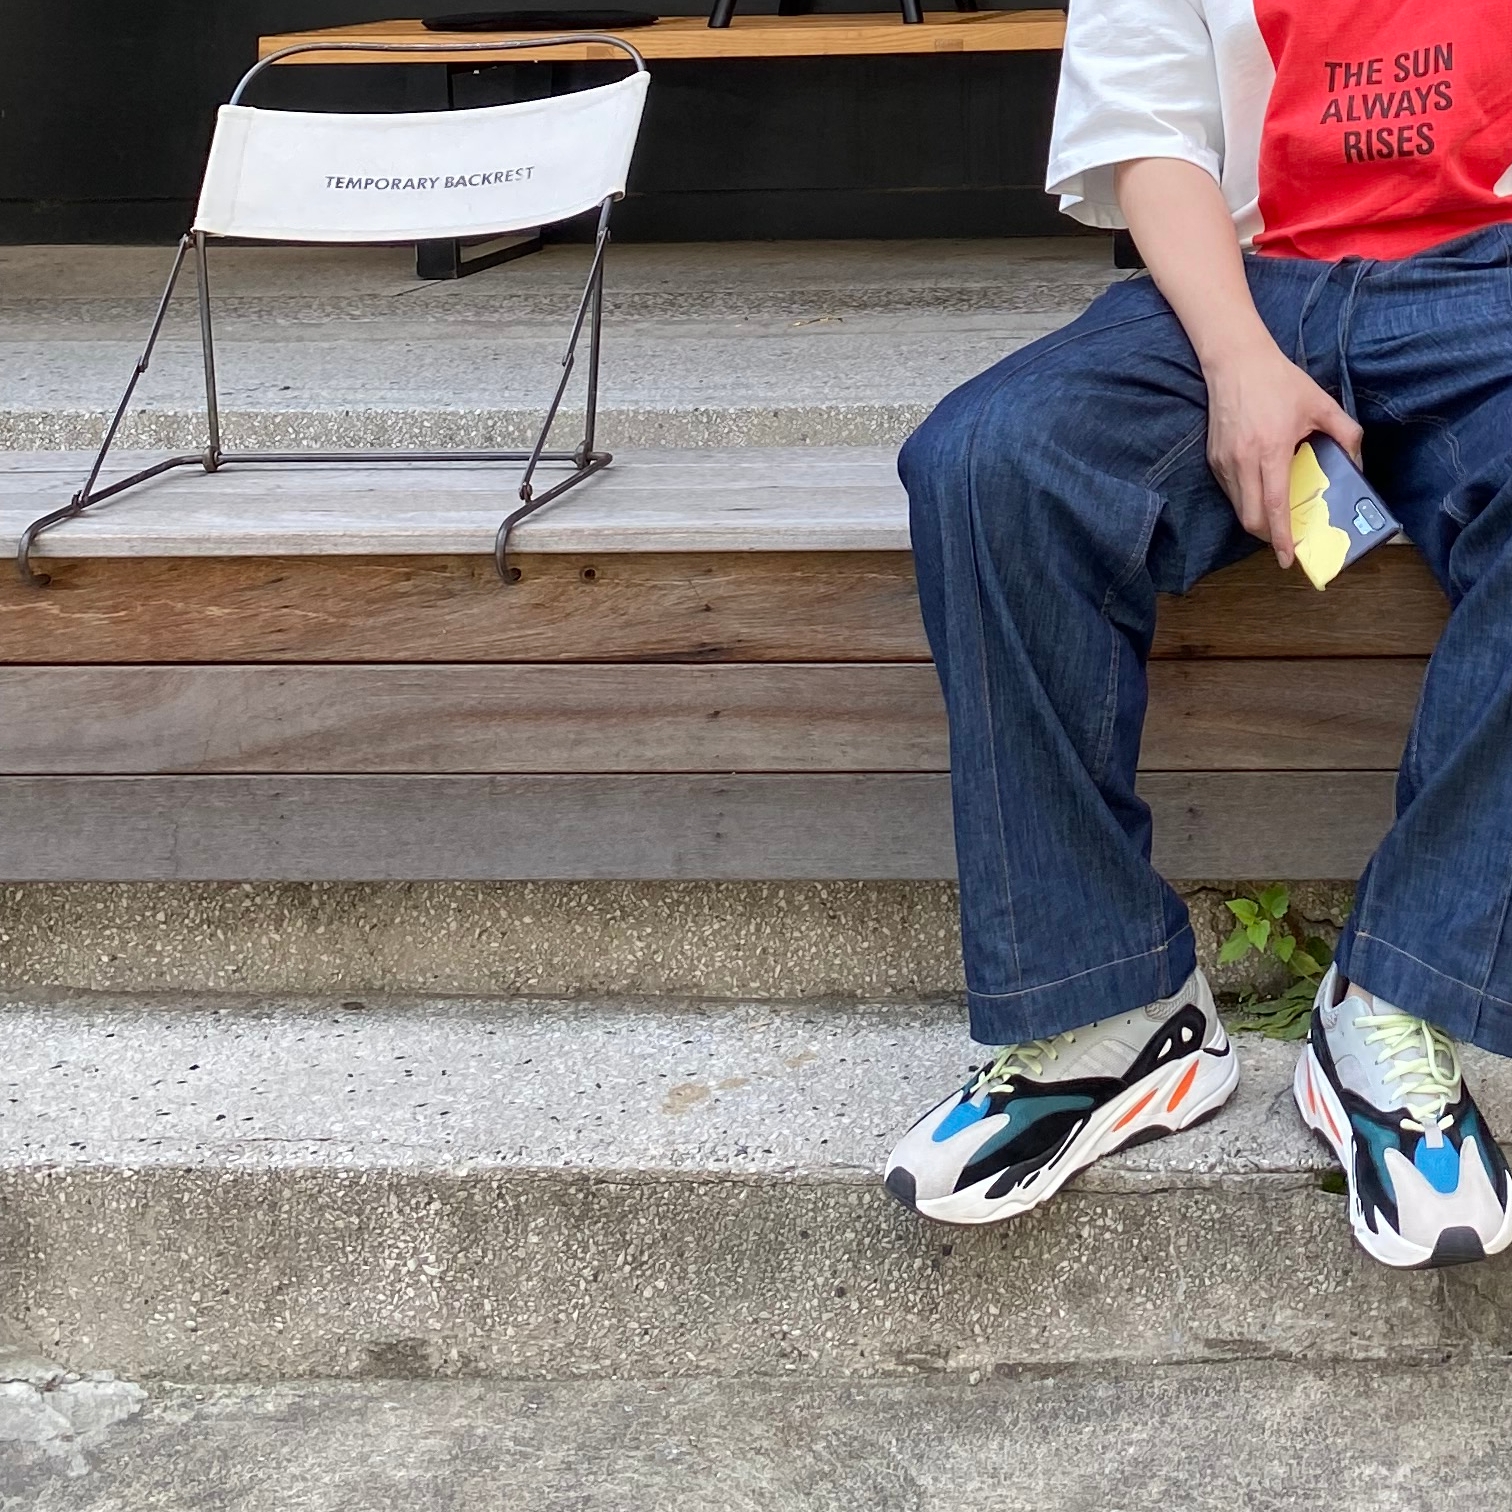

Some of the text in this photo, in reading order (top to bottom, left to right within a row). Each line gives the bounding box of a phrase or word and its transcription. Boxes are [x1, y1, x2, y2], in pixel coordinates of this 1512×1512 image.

[1324, 42, 1453, 93] THE SUN
[1319, 80, 1453, 125] ALWAYS
[1344, 122, 1435, 164] RISES
[325, 165, 535, 190] TEMPORARY BACKREST
